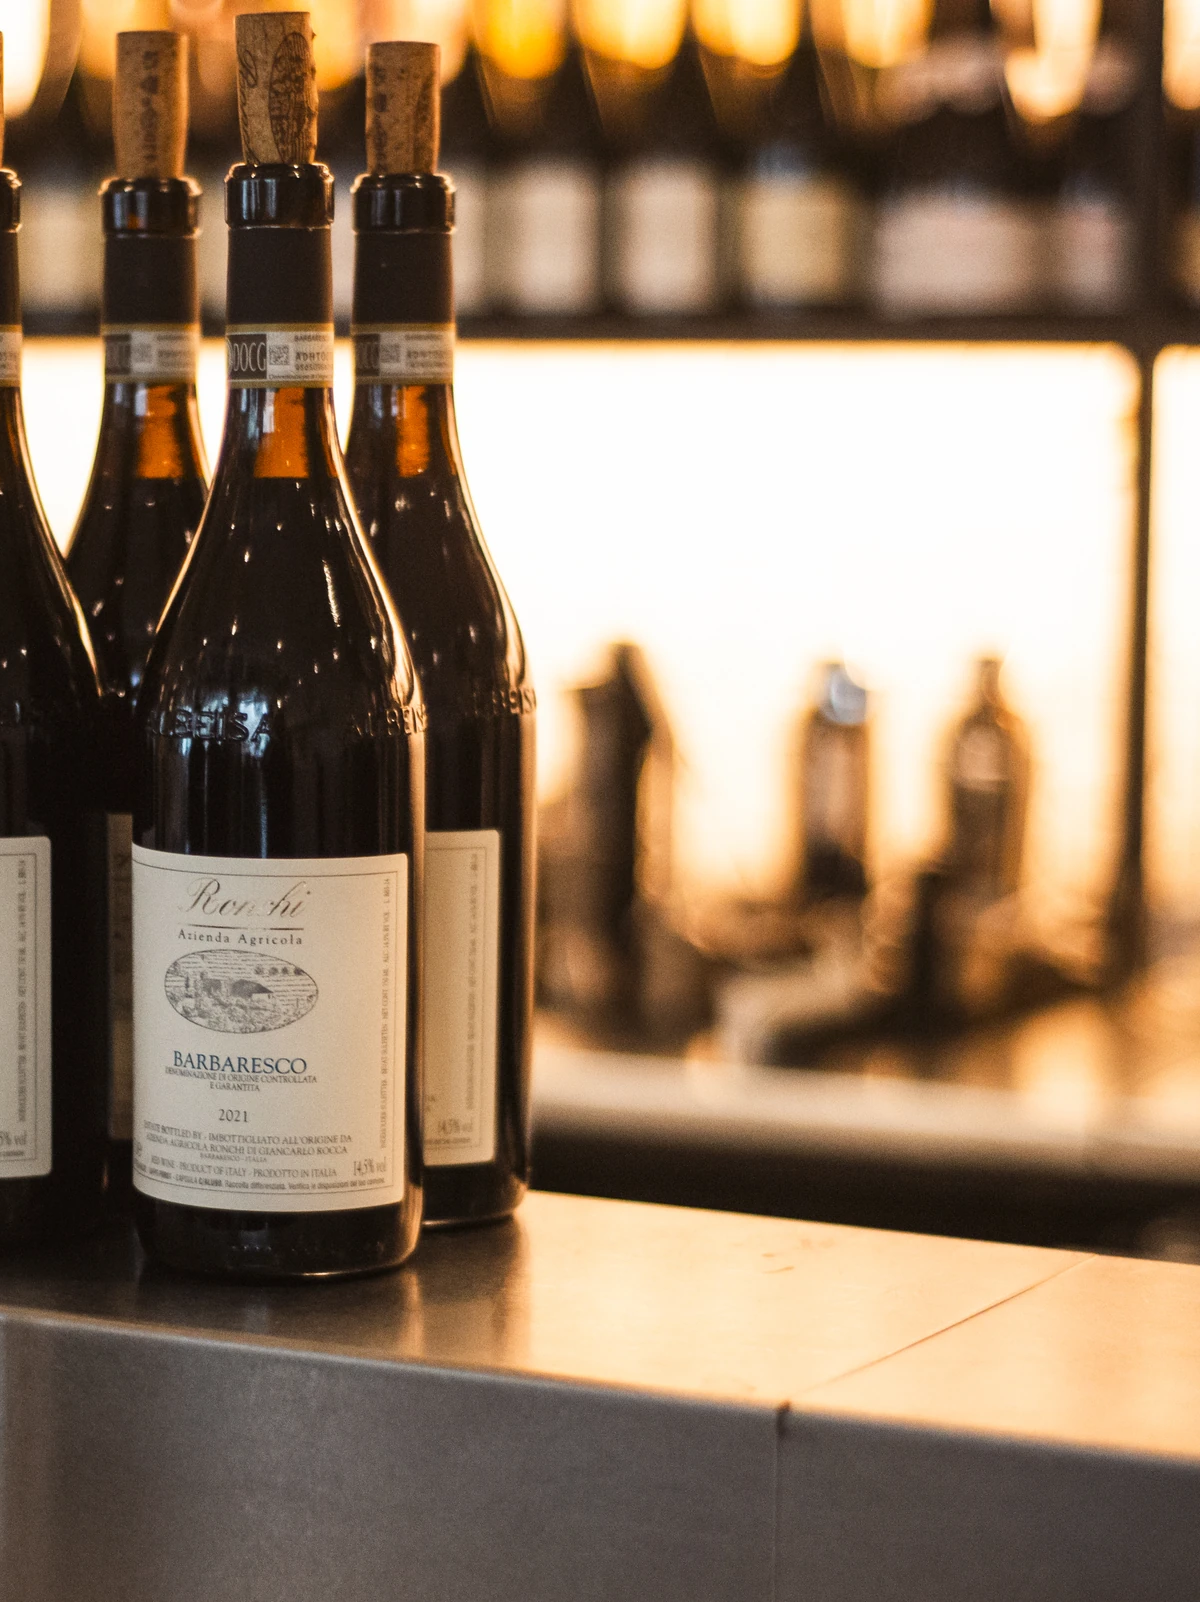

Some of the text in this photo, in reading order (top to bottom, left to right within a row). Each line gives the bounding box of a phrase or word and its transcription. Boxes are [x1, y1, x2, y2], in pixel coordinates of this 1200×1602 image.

[178, 929, 303, 946] Azienda Agricola
[174, 1050, 307, 1075] BARBARESCO
[165, 1066, 217, 1081] DENOMINAZIONE
[228, 1073, 259, 1083] ORIGINE
[260, 1075, 318, 1084] CONTROLLATA
[216, 1083, 260, 1092] GARANTITA
[219, 1109, 248, 1122] 2021
[209, 1132, 280, 1144] IMBOTTIGLIATO
[340, 1134, 352, 1143] DA
[210, 1144, 245, 1154] RONCHI
[247, 1146, 256, 1155] DI
[258, 1147, 315, 1156] GIANCARLO
[317, 1146, 348, 1156] ROCCA
[253, 1169, 299, 1178] PRODOTTO
[311, 1168, 337, 1177] ITALIA
